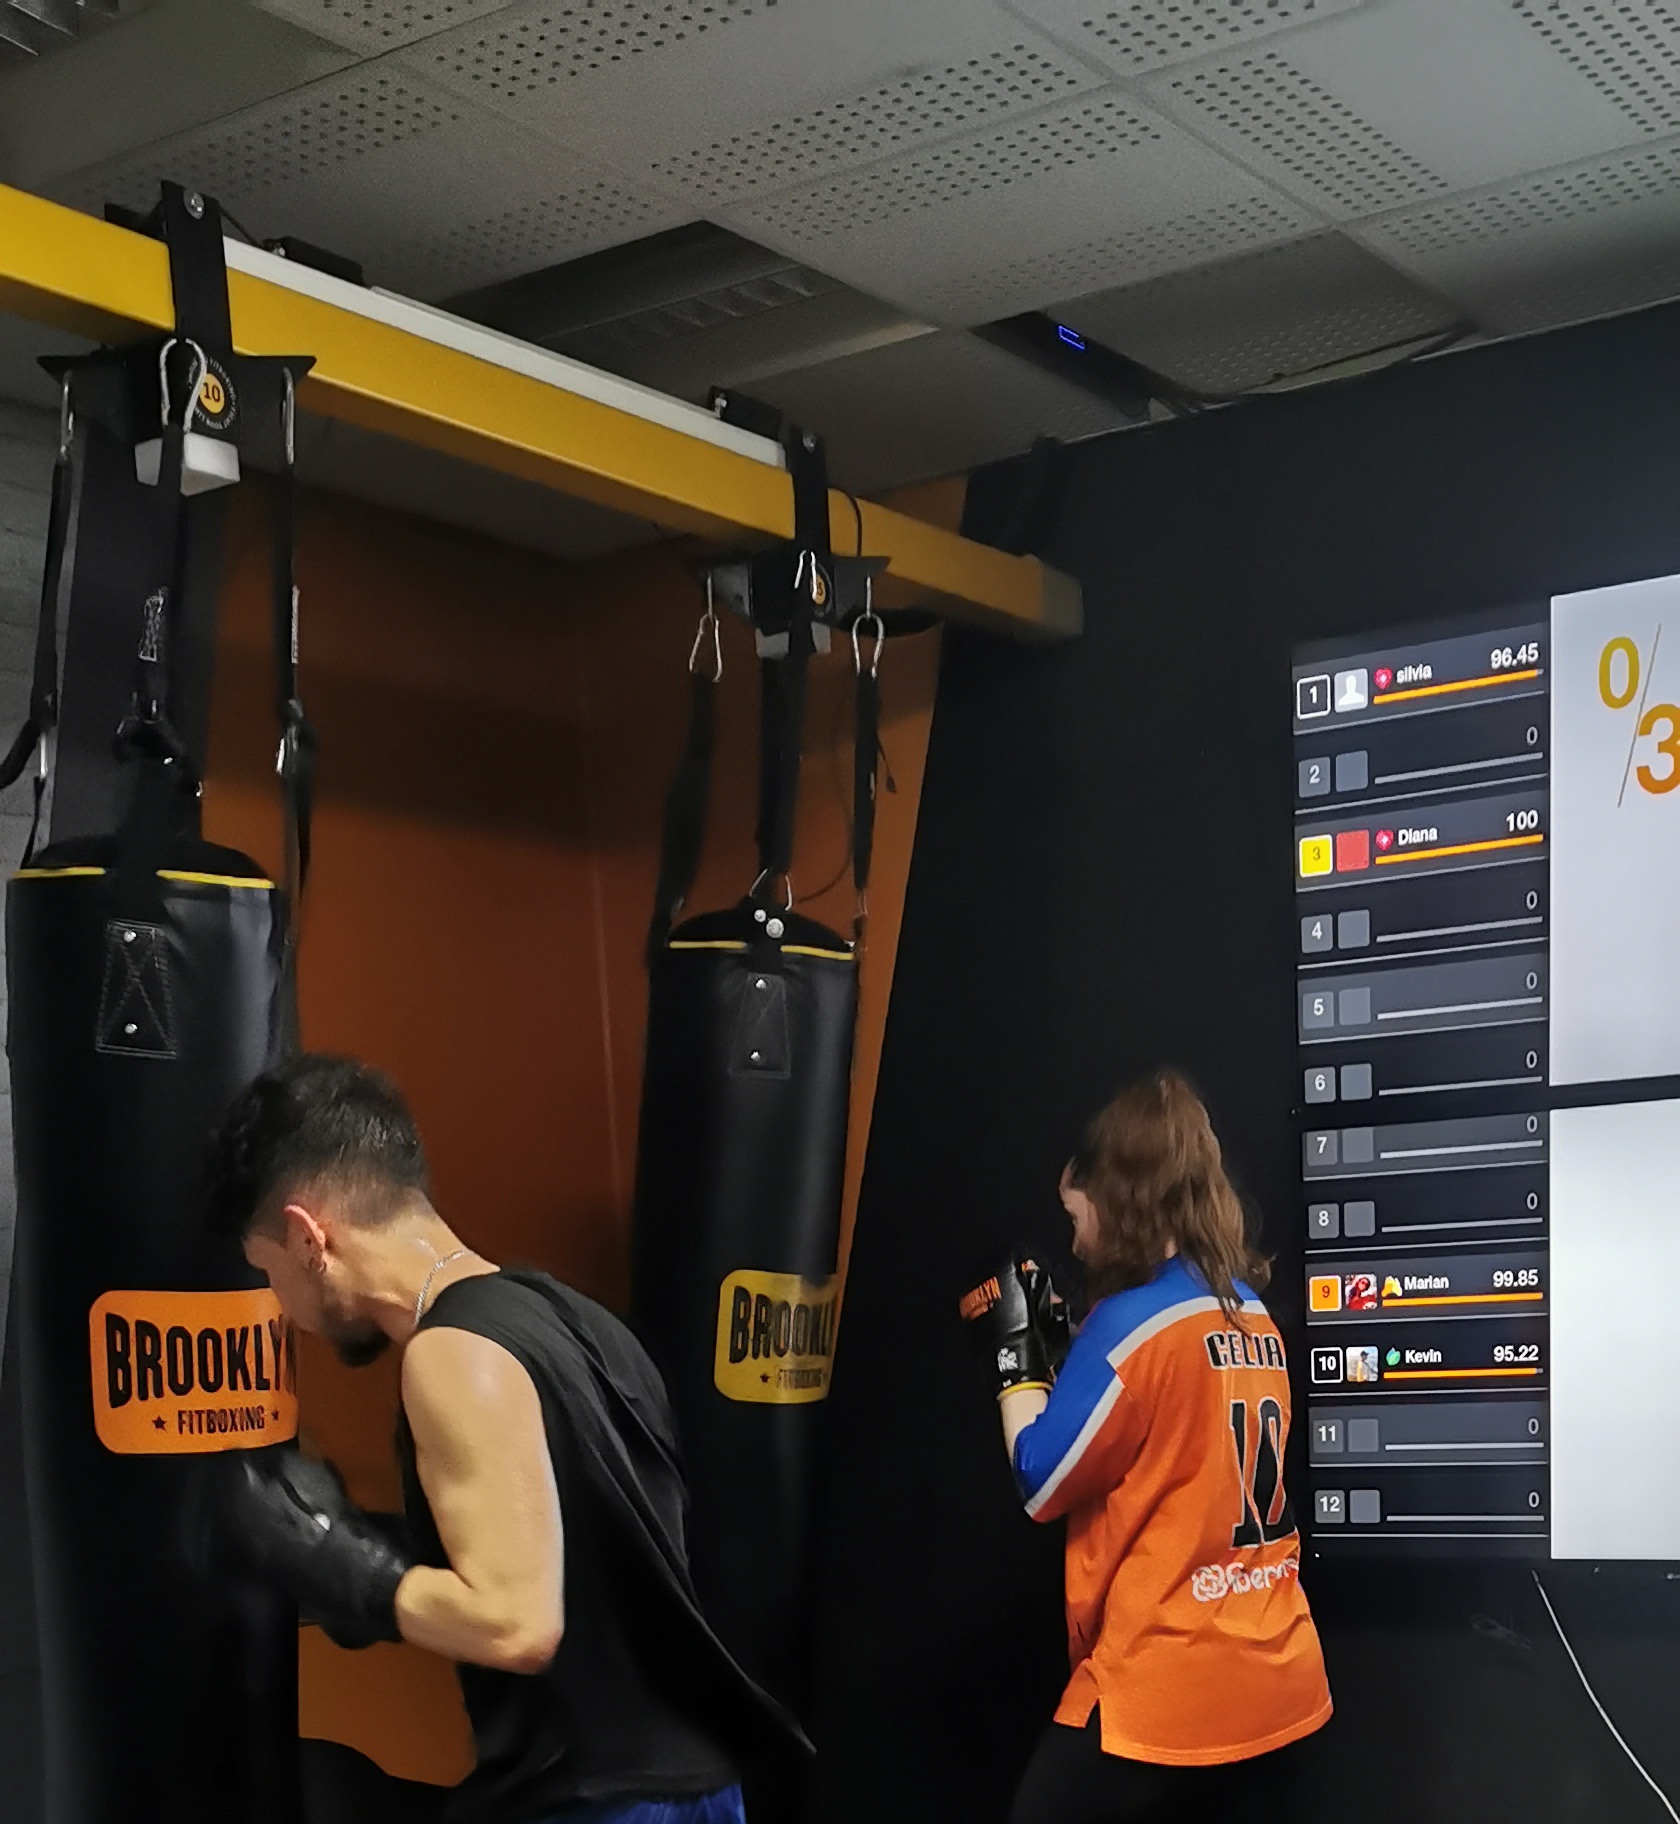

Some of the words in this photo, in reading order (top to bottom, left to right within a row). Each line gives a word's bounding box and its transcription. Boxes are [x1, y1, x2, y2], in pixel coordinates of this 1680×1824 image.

[203, 381, 221, 403] 10
[1309, 685, 1318, 704] 1
[1396, 663, 1433, 684] silvia
[1490, 642, 1539, 670] 96.45
[1309, 764, 1321, 784] 2
[1526, 726, 1538, 746] 0
[1312, 846, 1321, 861] 3
[1398, 827, 1438, 846] Diana
[1505, 809, 1539, 832] 100
[1311, 921, 1323, 940] 4
[1526, 890, 1538, 911] 0
[1313, 998, 1324, 1016] 5
[1526, 971, 1538, 990] 0
[1314, 1074, 1326, 1091] 6
[1526, 1050, 1538, 1069] 0
[1316, 1136, 1328, 1154] 7
[1526, 1114, 1538, 1133] 0
[1318, 1210, 1330, 1227] 8
[1526, 1192, 1538, 1210] 0
[1321, 1285, 1331, 1299] 9
[1403, 1274, 1450, 1291] Marian
[1492, 1268, 1539, 1288] 99.85
[1204, 1331, 1287, 1371] CELIA
[1318, 1355, 1337, 1372] 10
[1405, 1348, 1442, 1364] Kevin
[1493, 1344, 1539, 1363] 95.22
[177, 1404, 265, 1435] FITBOXING
[1318, 1425, 1336, 1442] 11
[1528, 1418, 1539, 1435] 0
[1229, 1396, 1299, 1549] 10
[1319, 1495, 1341, 1513] 12
[1528, 1491, 1540, 1508] 0
